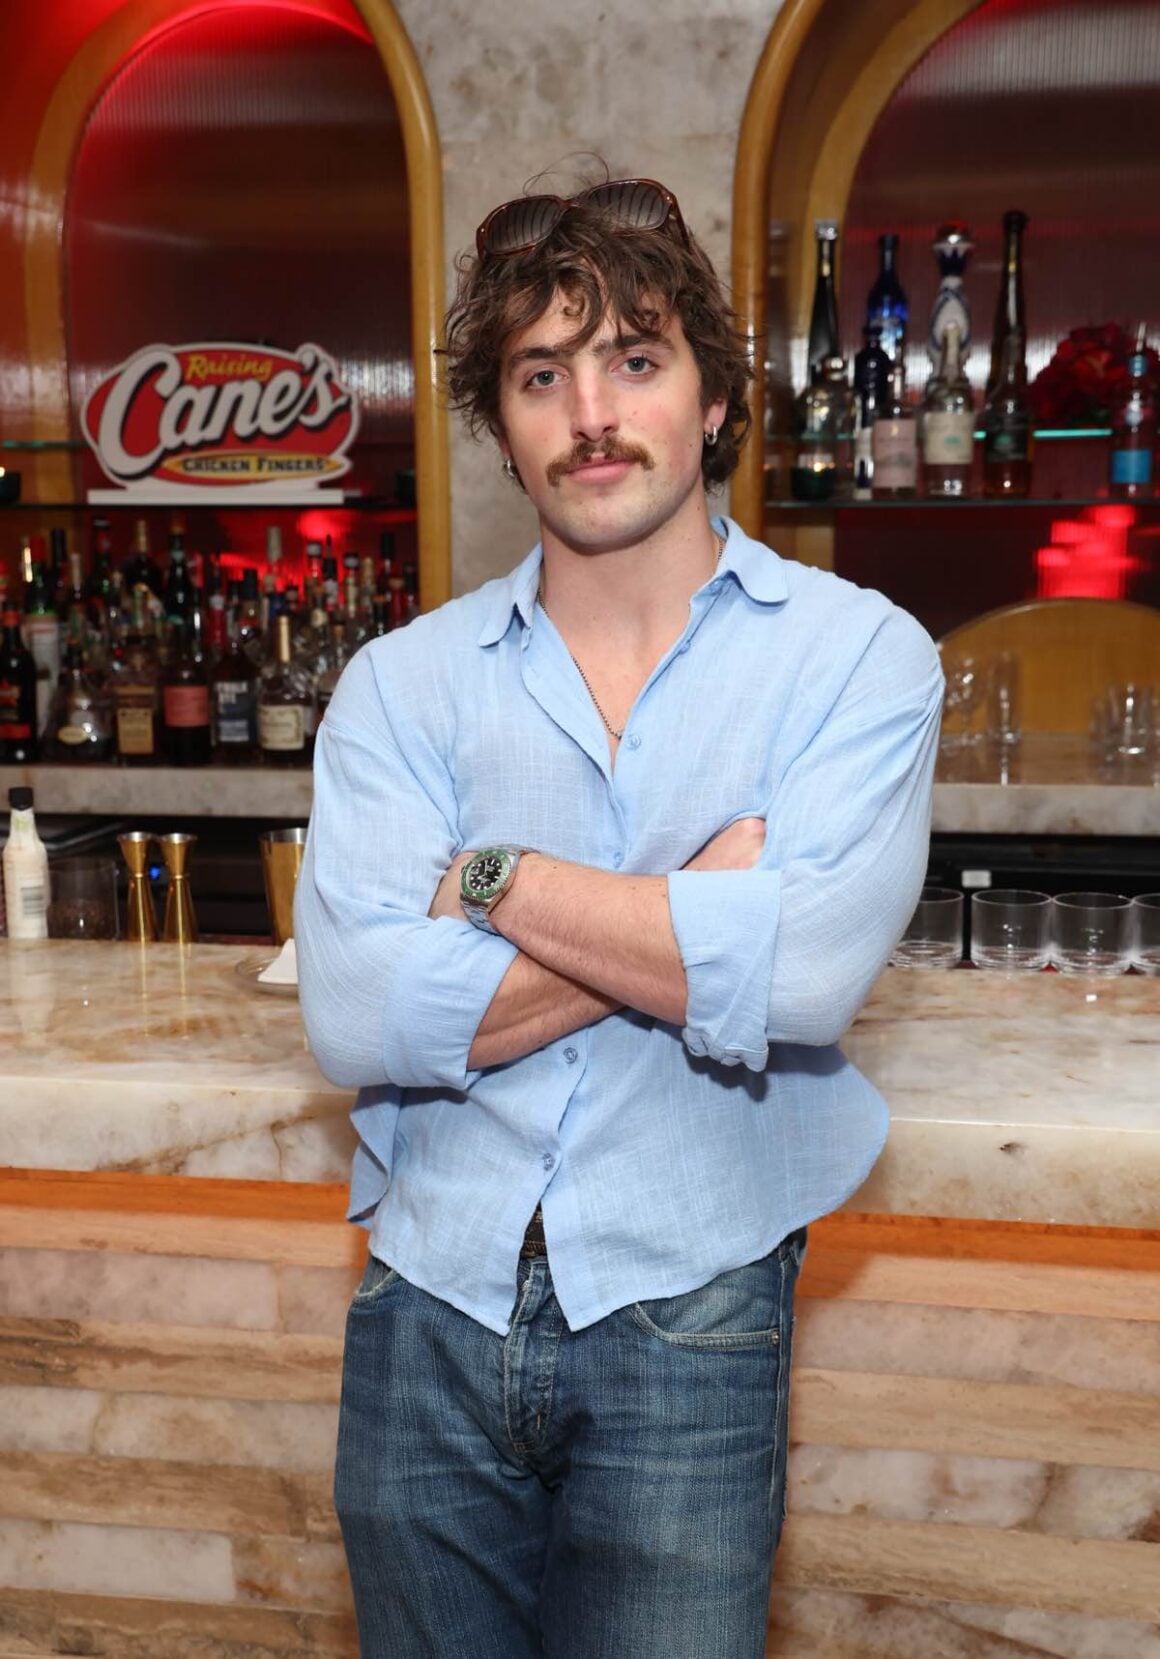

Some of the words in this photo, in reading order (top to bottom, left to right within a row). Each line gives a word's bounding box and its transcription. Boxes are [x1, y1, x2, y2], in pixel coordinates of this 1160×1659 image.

[186, 353, 273, 381] Raising
[99, 348, 351, 476] Cane's
[182, 458, 250, 472] CHICKEN
[257, 457, 325, 473] FINGERS
